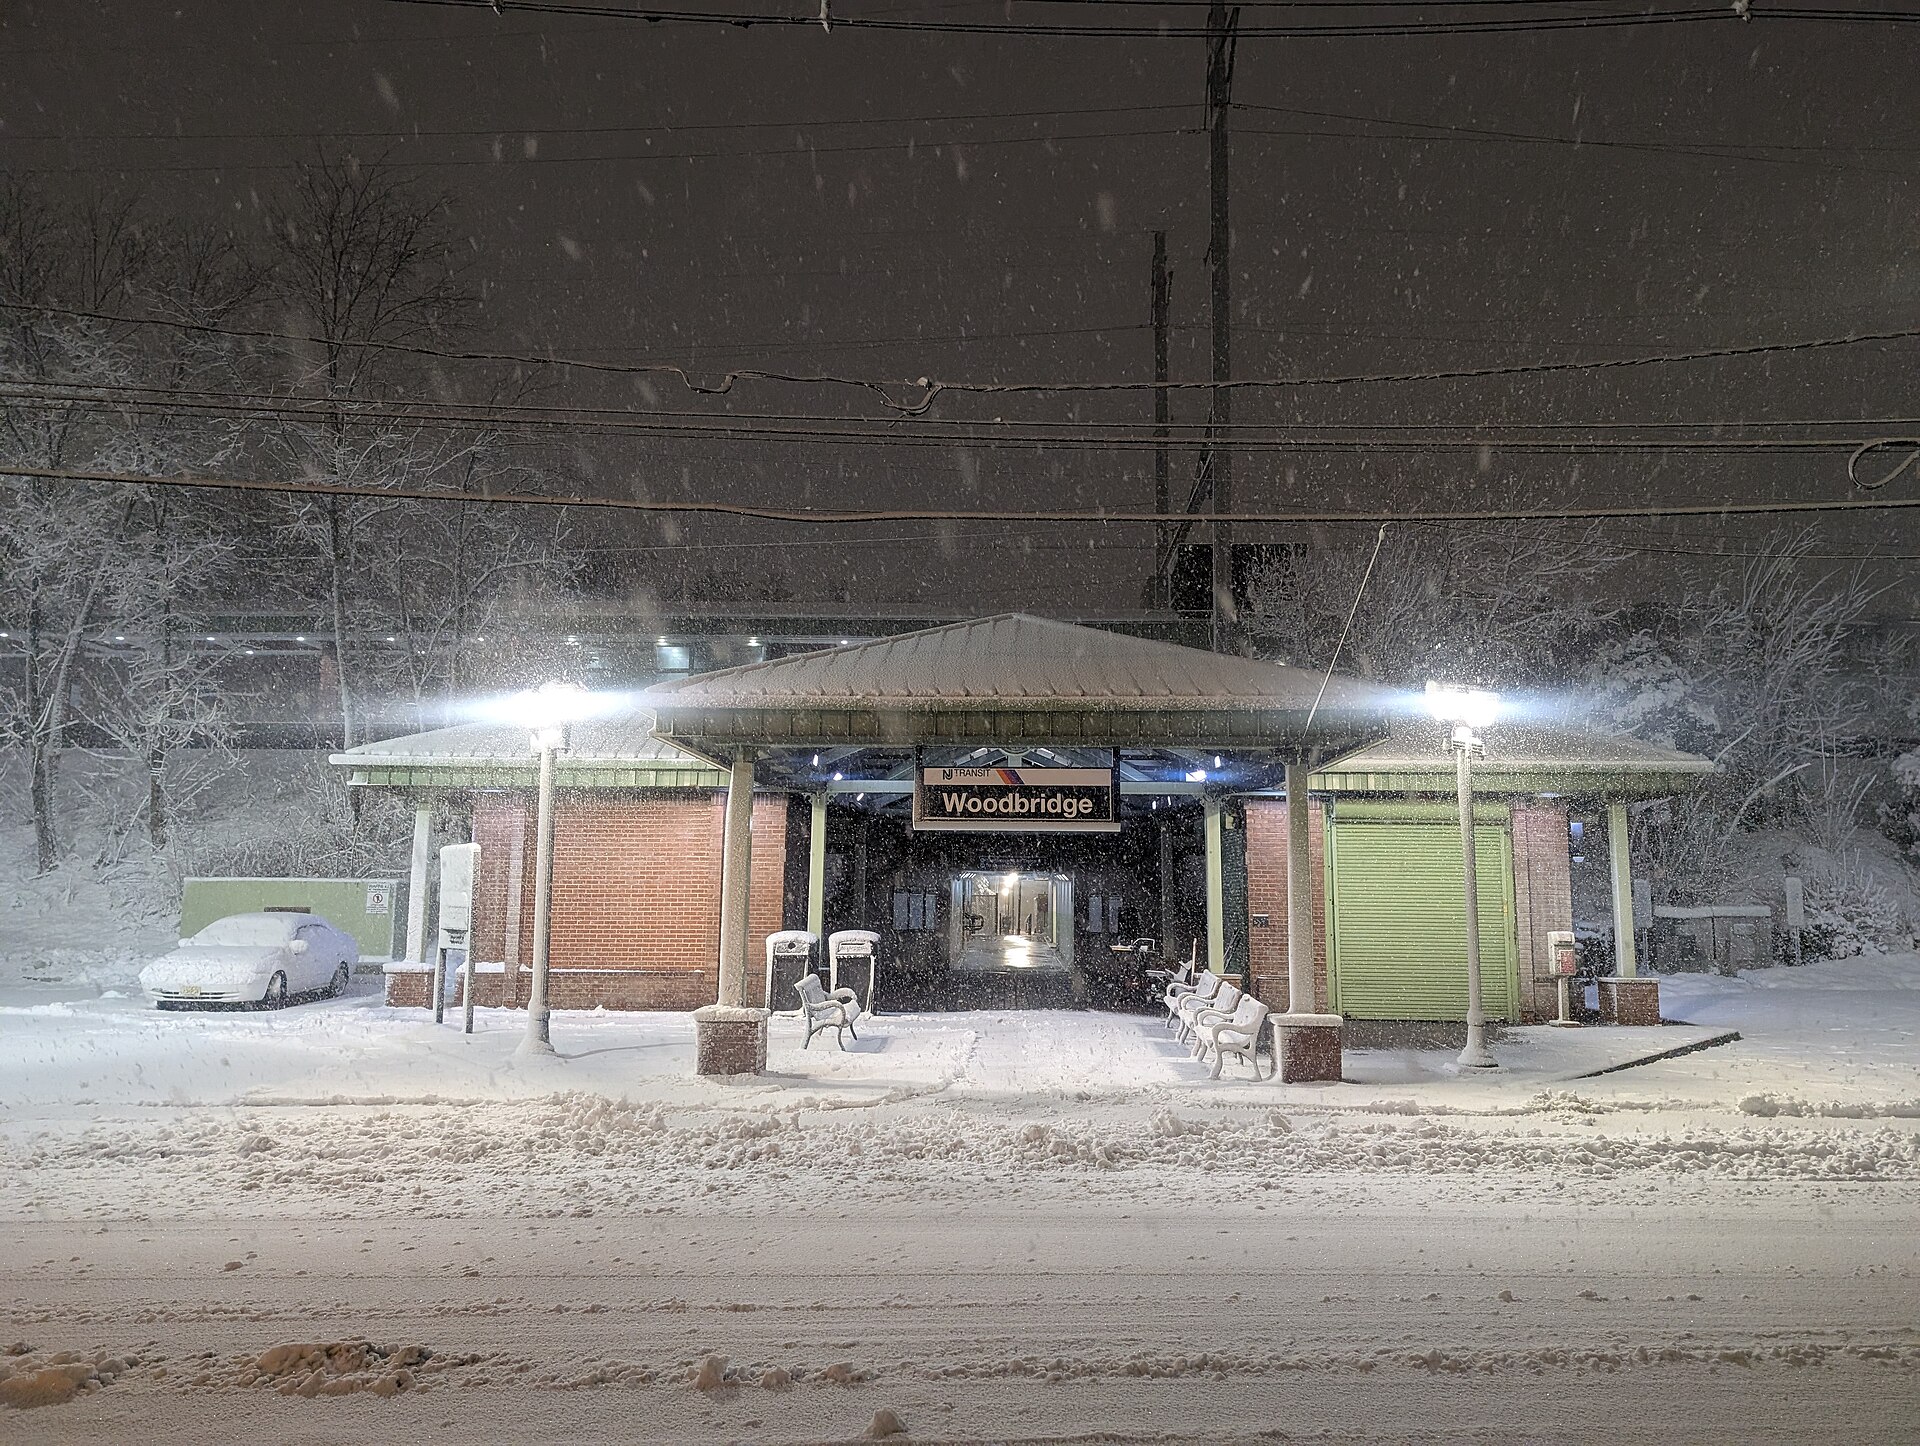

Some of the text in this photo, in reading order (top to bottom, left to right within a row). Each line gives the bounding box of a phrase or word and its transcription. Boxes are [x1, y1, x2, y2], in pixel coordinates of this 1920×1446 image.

[942, 768, 991, 780] NJ TRANSIT
[942, 792, 1093, 818] Woodbridge
